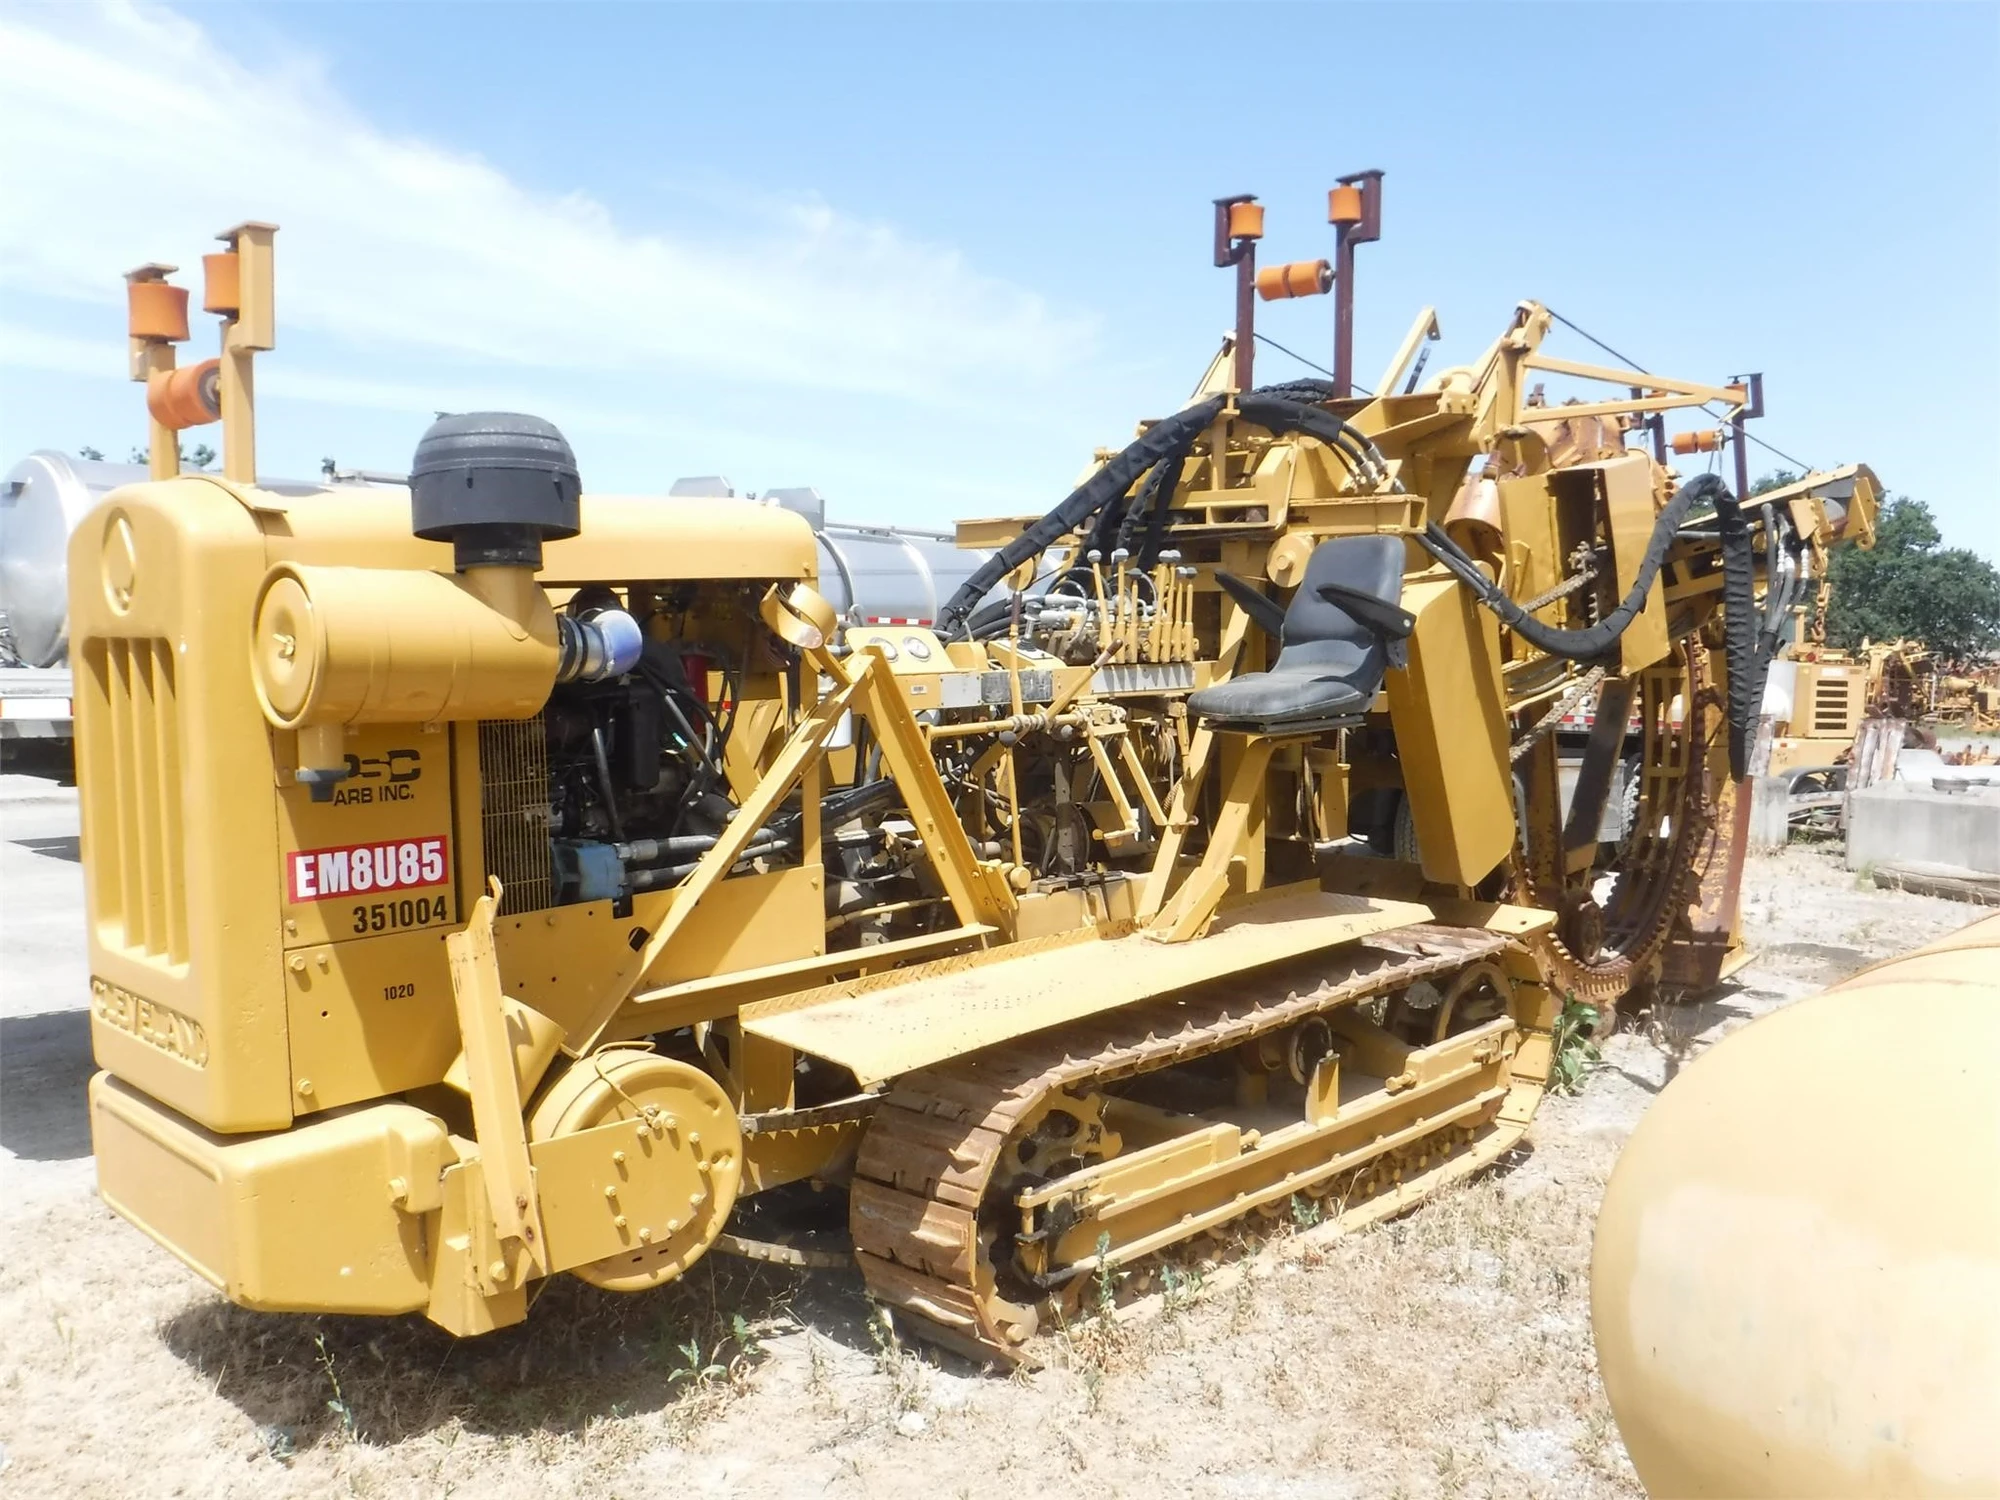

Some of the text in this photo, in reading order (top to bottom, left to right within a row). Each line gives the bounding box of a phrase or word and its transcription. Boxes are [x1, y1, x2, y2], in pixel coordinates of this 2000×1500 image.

[333, 784, 414, 807] ARB INC.
[295, 840, 443, 898] EM8U85
[353, 895, 447, 934] 351004
[384, 983, 415, 1001] 1020
